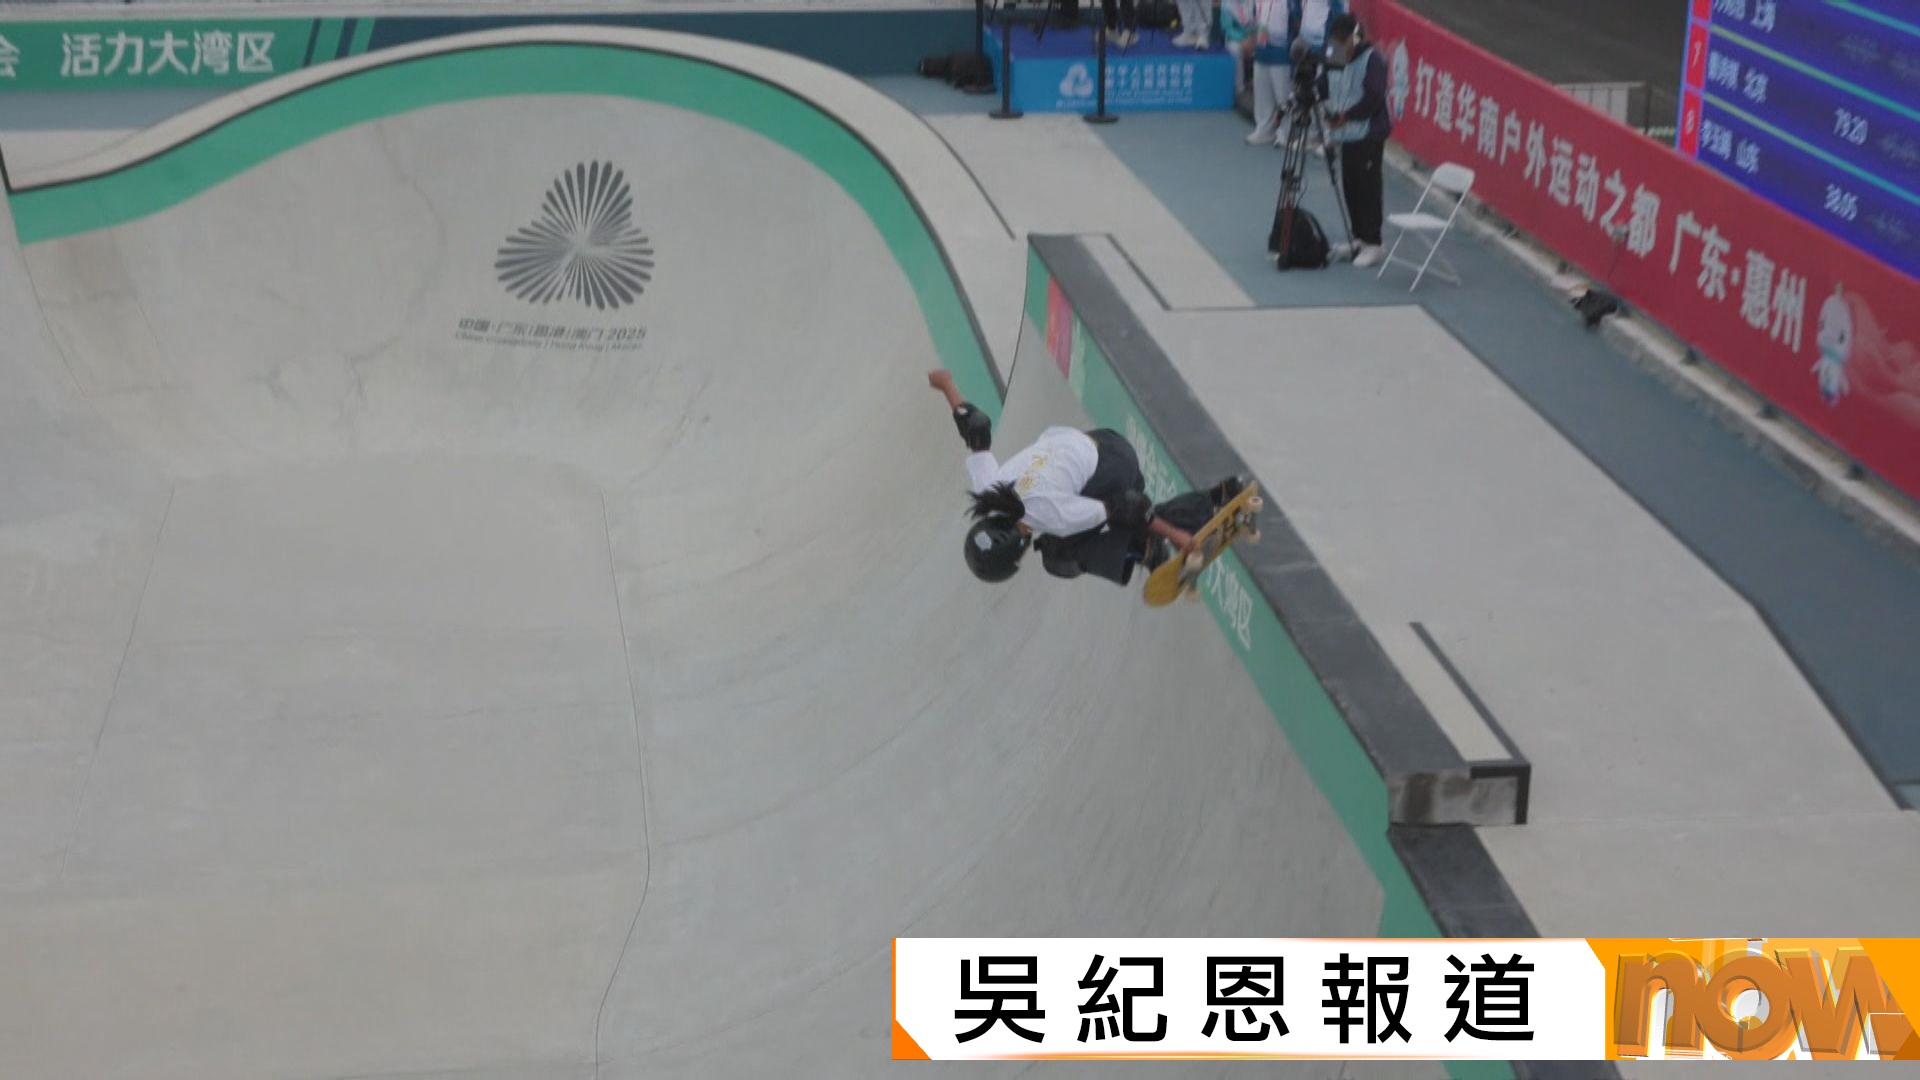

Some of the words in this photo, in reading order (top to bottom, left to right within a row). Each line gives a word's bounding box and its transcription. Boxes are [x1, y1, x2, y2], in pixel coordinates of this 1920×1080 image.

[61, 30, 275, 77] 活力大湾区
[1414, 56, 1660, 258] 打造华南户外运动之都
[1669, 210, 1807, 353] 广东·惠州
[1206, 554, 1254, 653] 大湾区
